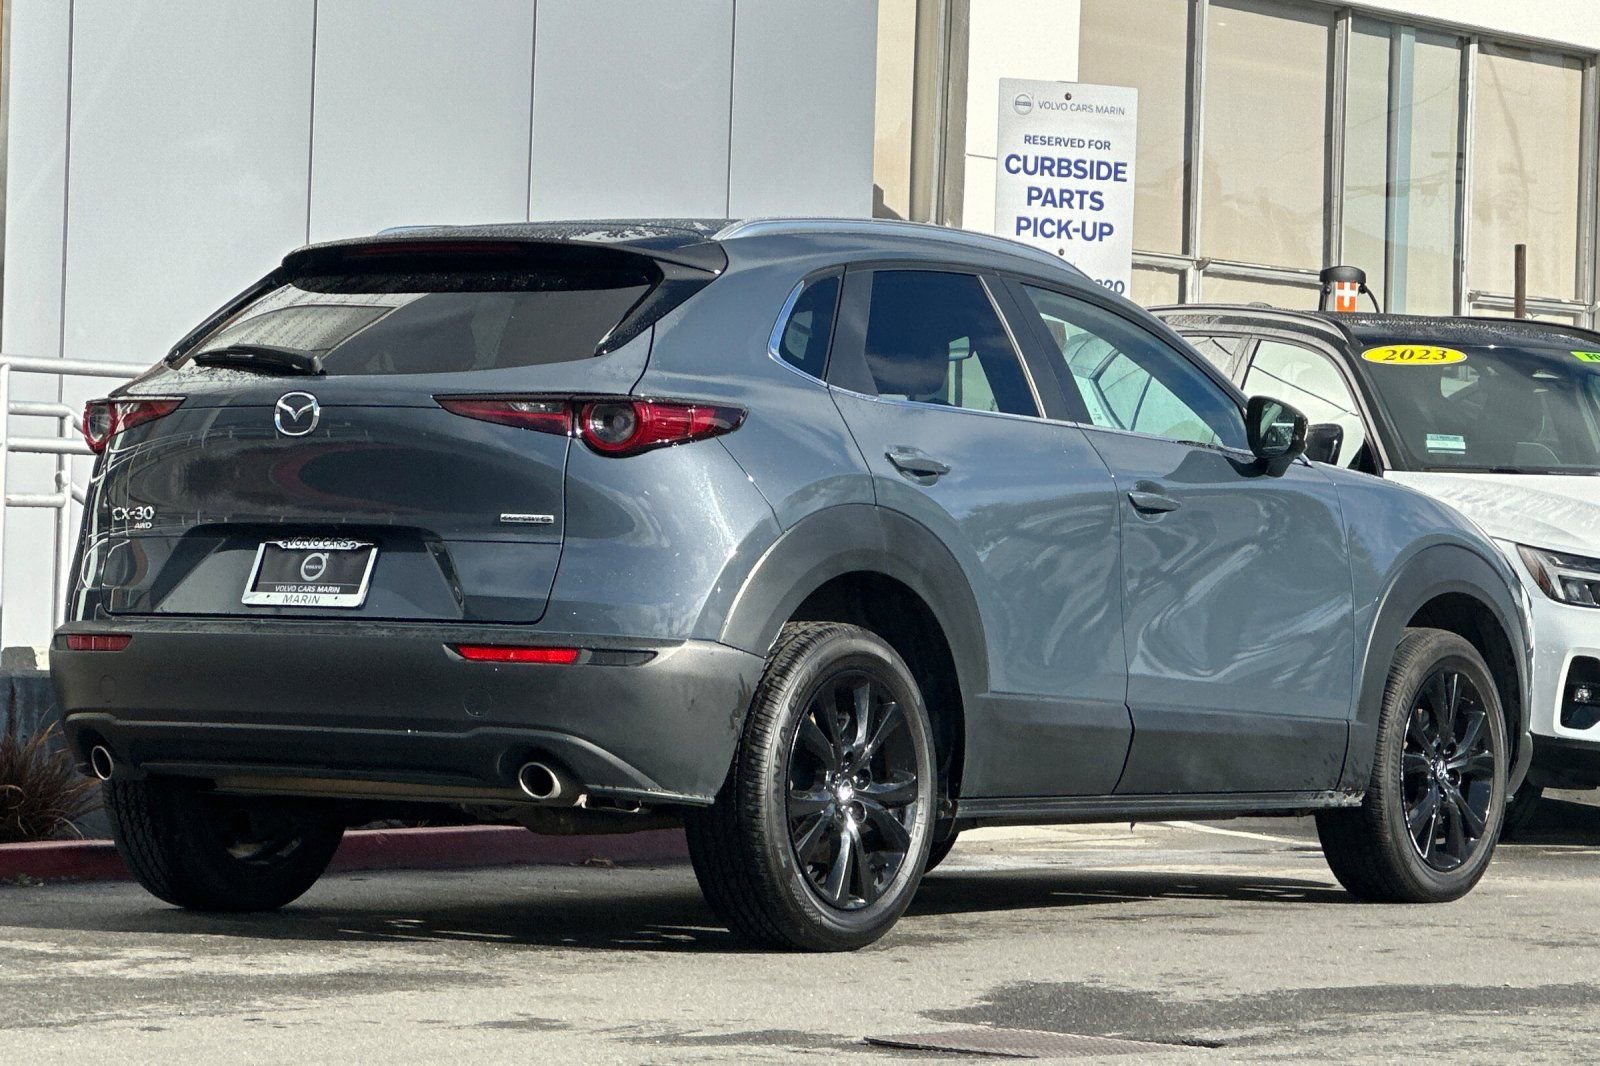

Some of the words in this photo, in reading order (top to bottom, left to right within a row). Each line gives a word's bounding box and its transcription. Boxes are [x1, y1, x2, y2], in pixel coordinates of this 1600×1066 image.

[1038, 100, 1068, 112] VOLVO
[1070, 103, 1093, 113] CARS
[1095, 105, 1125, 116] MARIN
[1024, 134, 1085, 149] RESERVED
[1088, 139, 1111, 150] FOR
[1005, 153, 1128, 182] CURBSIDE
[1026, 186, 1105, 211] PARTS
[1015, 216, 1114, 242] PICK-UP
[1383, 348, 1447, 361] 2023
[112, 506, 154, 521] CX-30
[289, 536, 320, 548] VOLVO
[323, 537, 349, 548] CARS
[282, 594, 320, 604] MARIN
